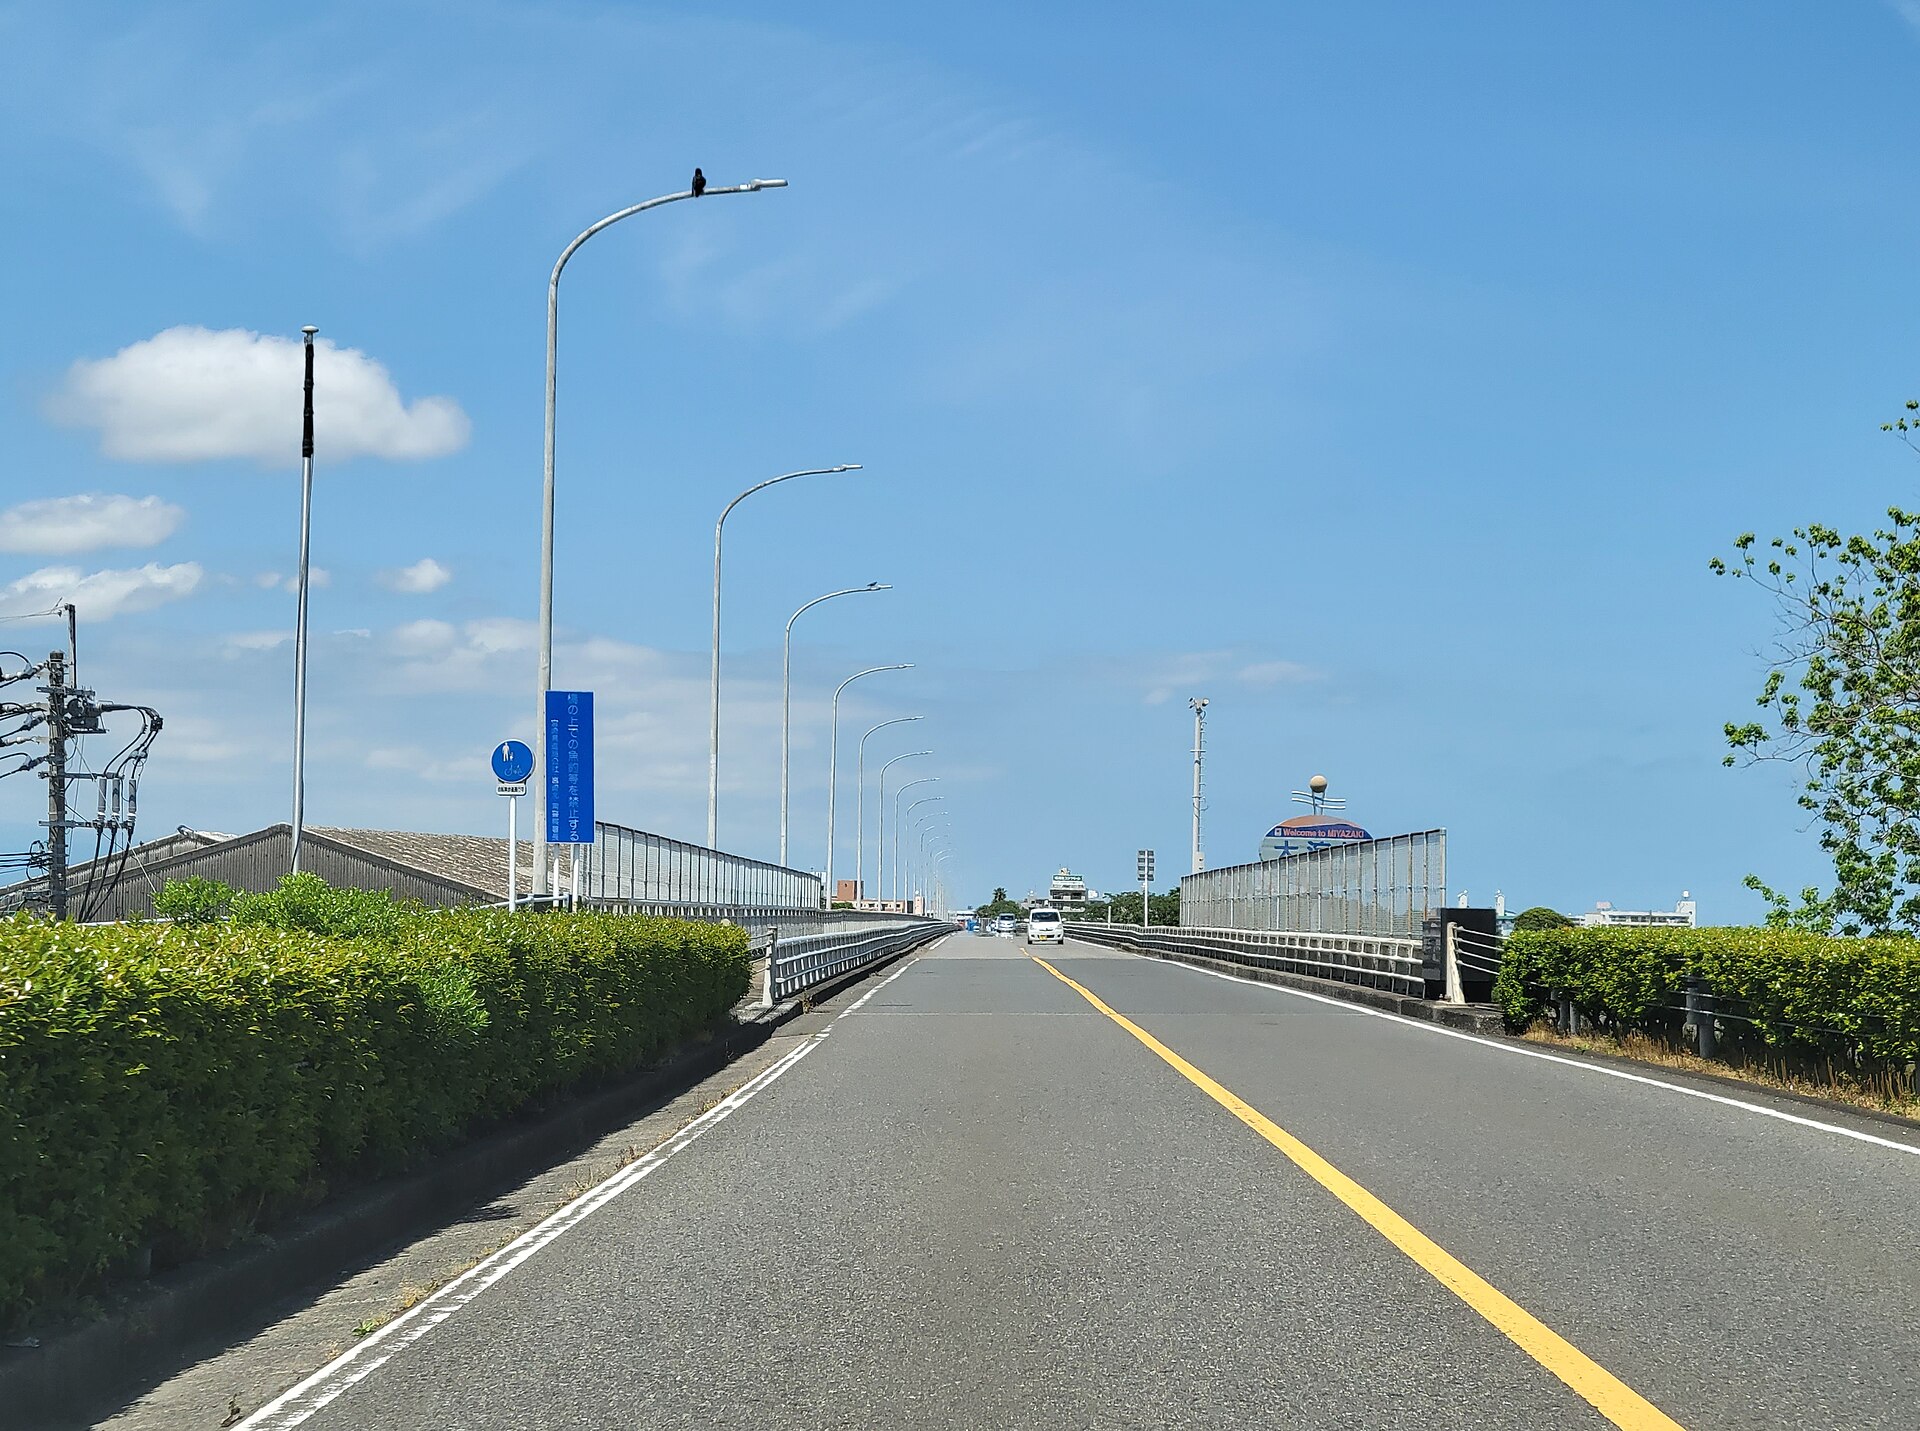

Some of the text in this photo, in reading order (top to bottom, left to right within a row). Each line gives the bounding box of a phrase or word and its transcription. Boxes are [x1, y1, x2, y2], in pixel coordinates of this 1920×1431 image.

[1283, 828, 1364, 838] Welcome to MIYAZAKI
